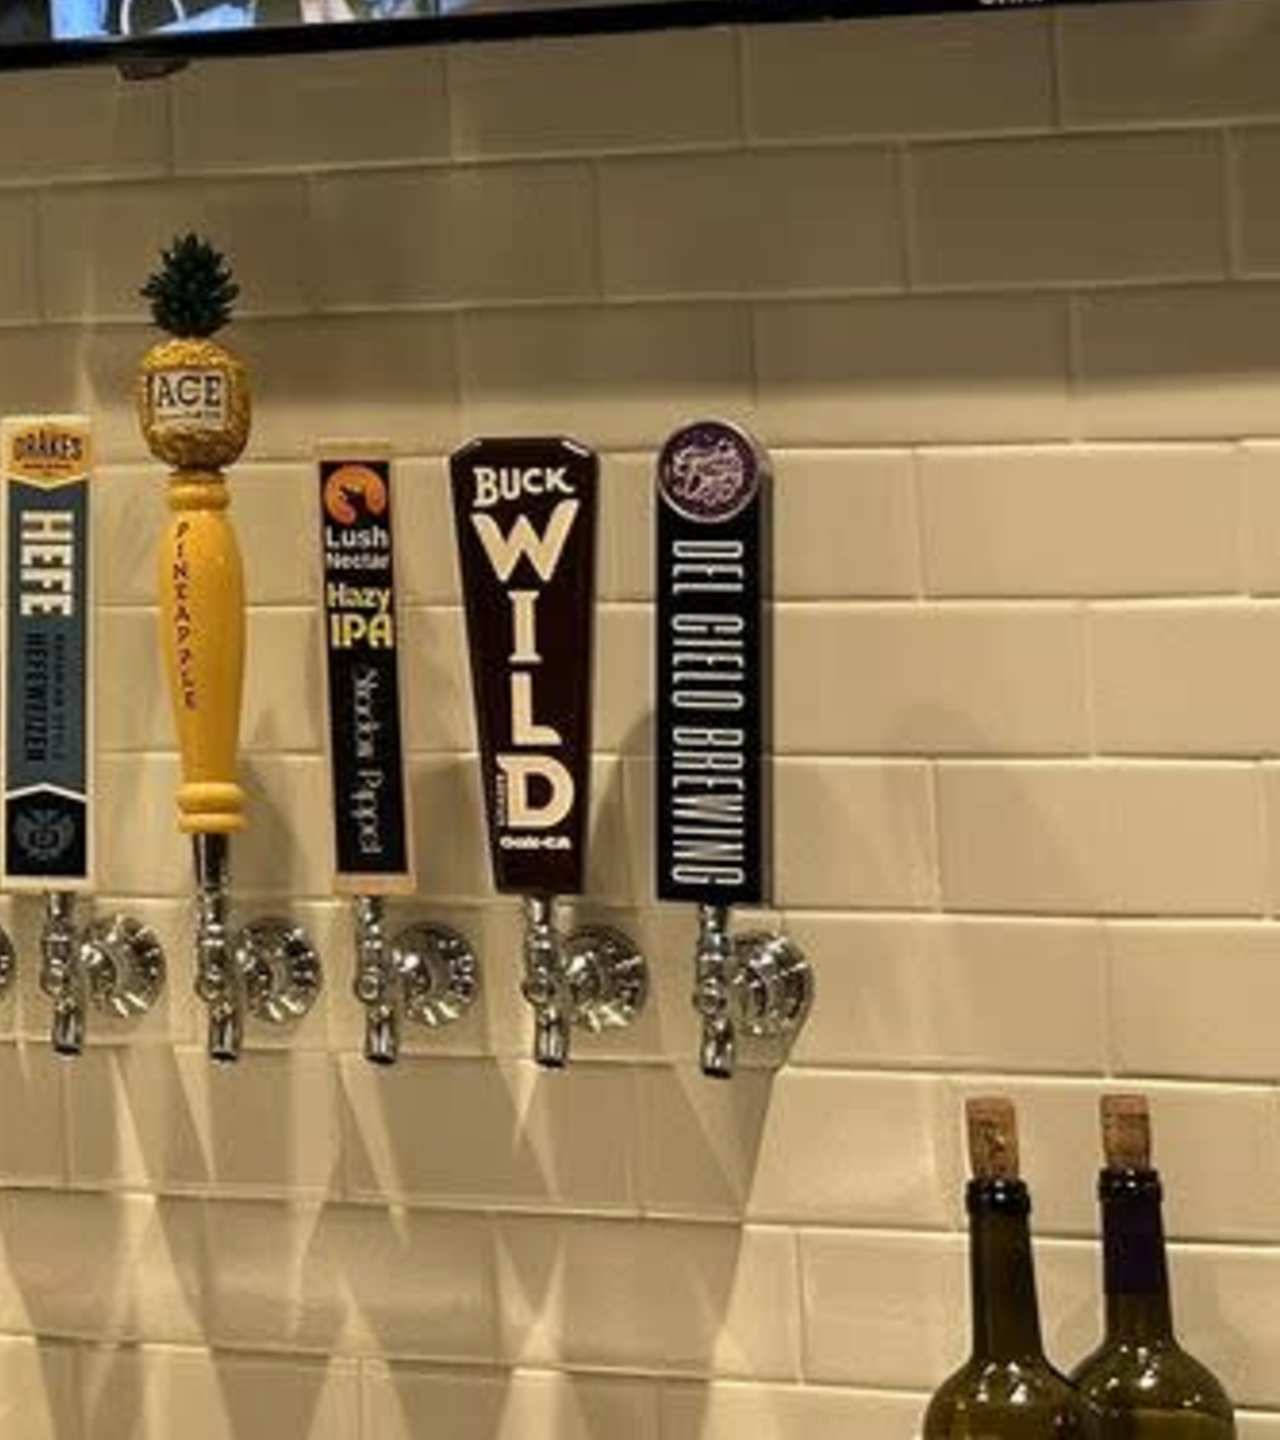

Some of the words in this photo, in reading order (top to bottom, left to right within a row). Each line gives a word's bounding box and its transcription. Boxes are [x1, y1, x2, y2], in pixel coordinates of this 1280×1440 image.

[156, 375, 223, 408] ACE
[472, 467, 576, 509] BUCK
[19, 511, 74, 617] HEFE
[325, 527, 389, 549] Lush
[671, 540, 745, 596] DEL
[173, 521, 197, 710] PINEAPPLE
[326, 582, 391, 614] Hazy
[330, 614, 394, 650] IPA
[470, 498, 582, 829] WILD
[670, 613, 745, 710] CIELO
[670, 727, 746, 885] BREWING
